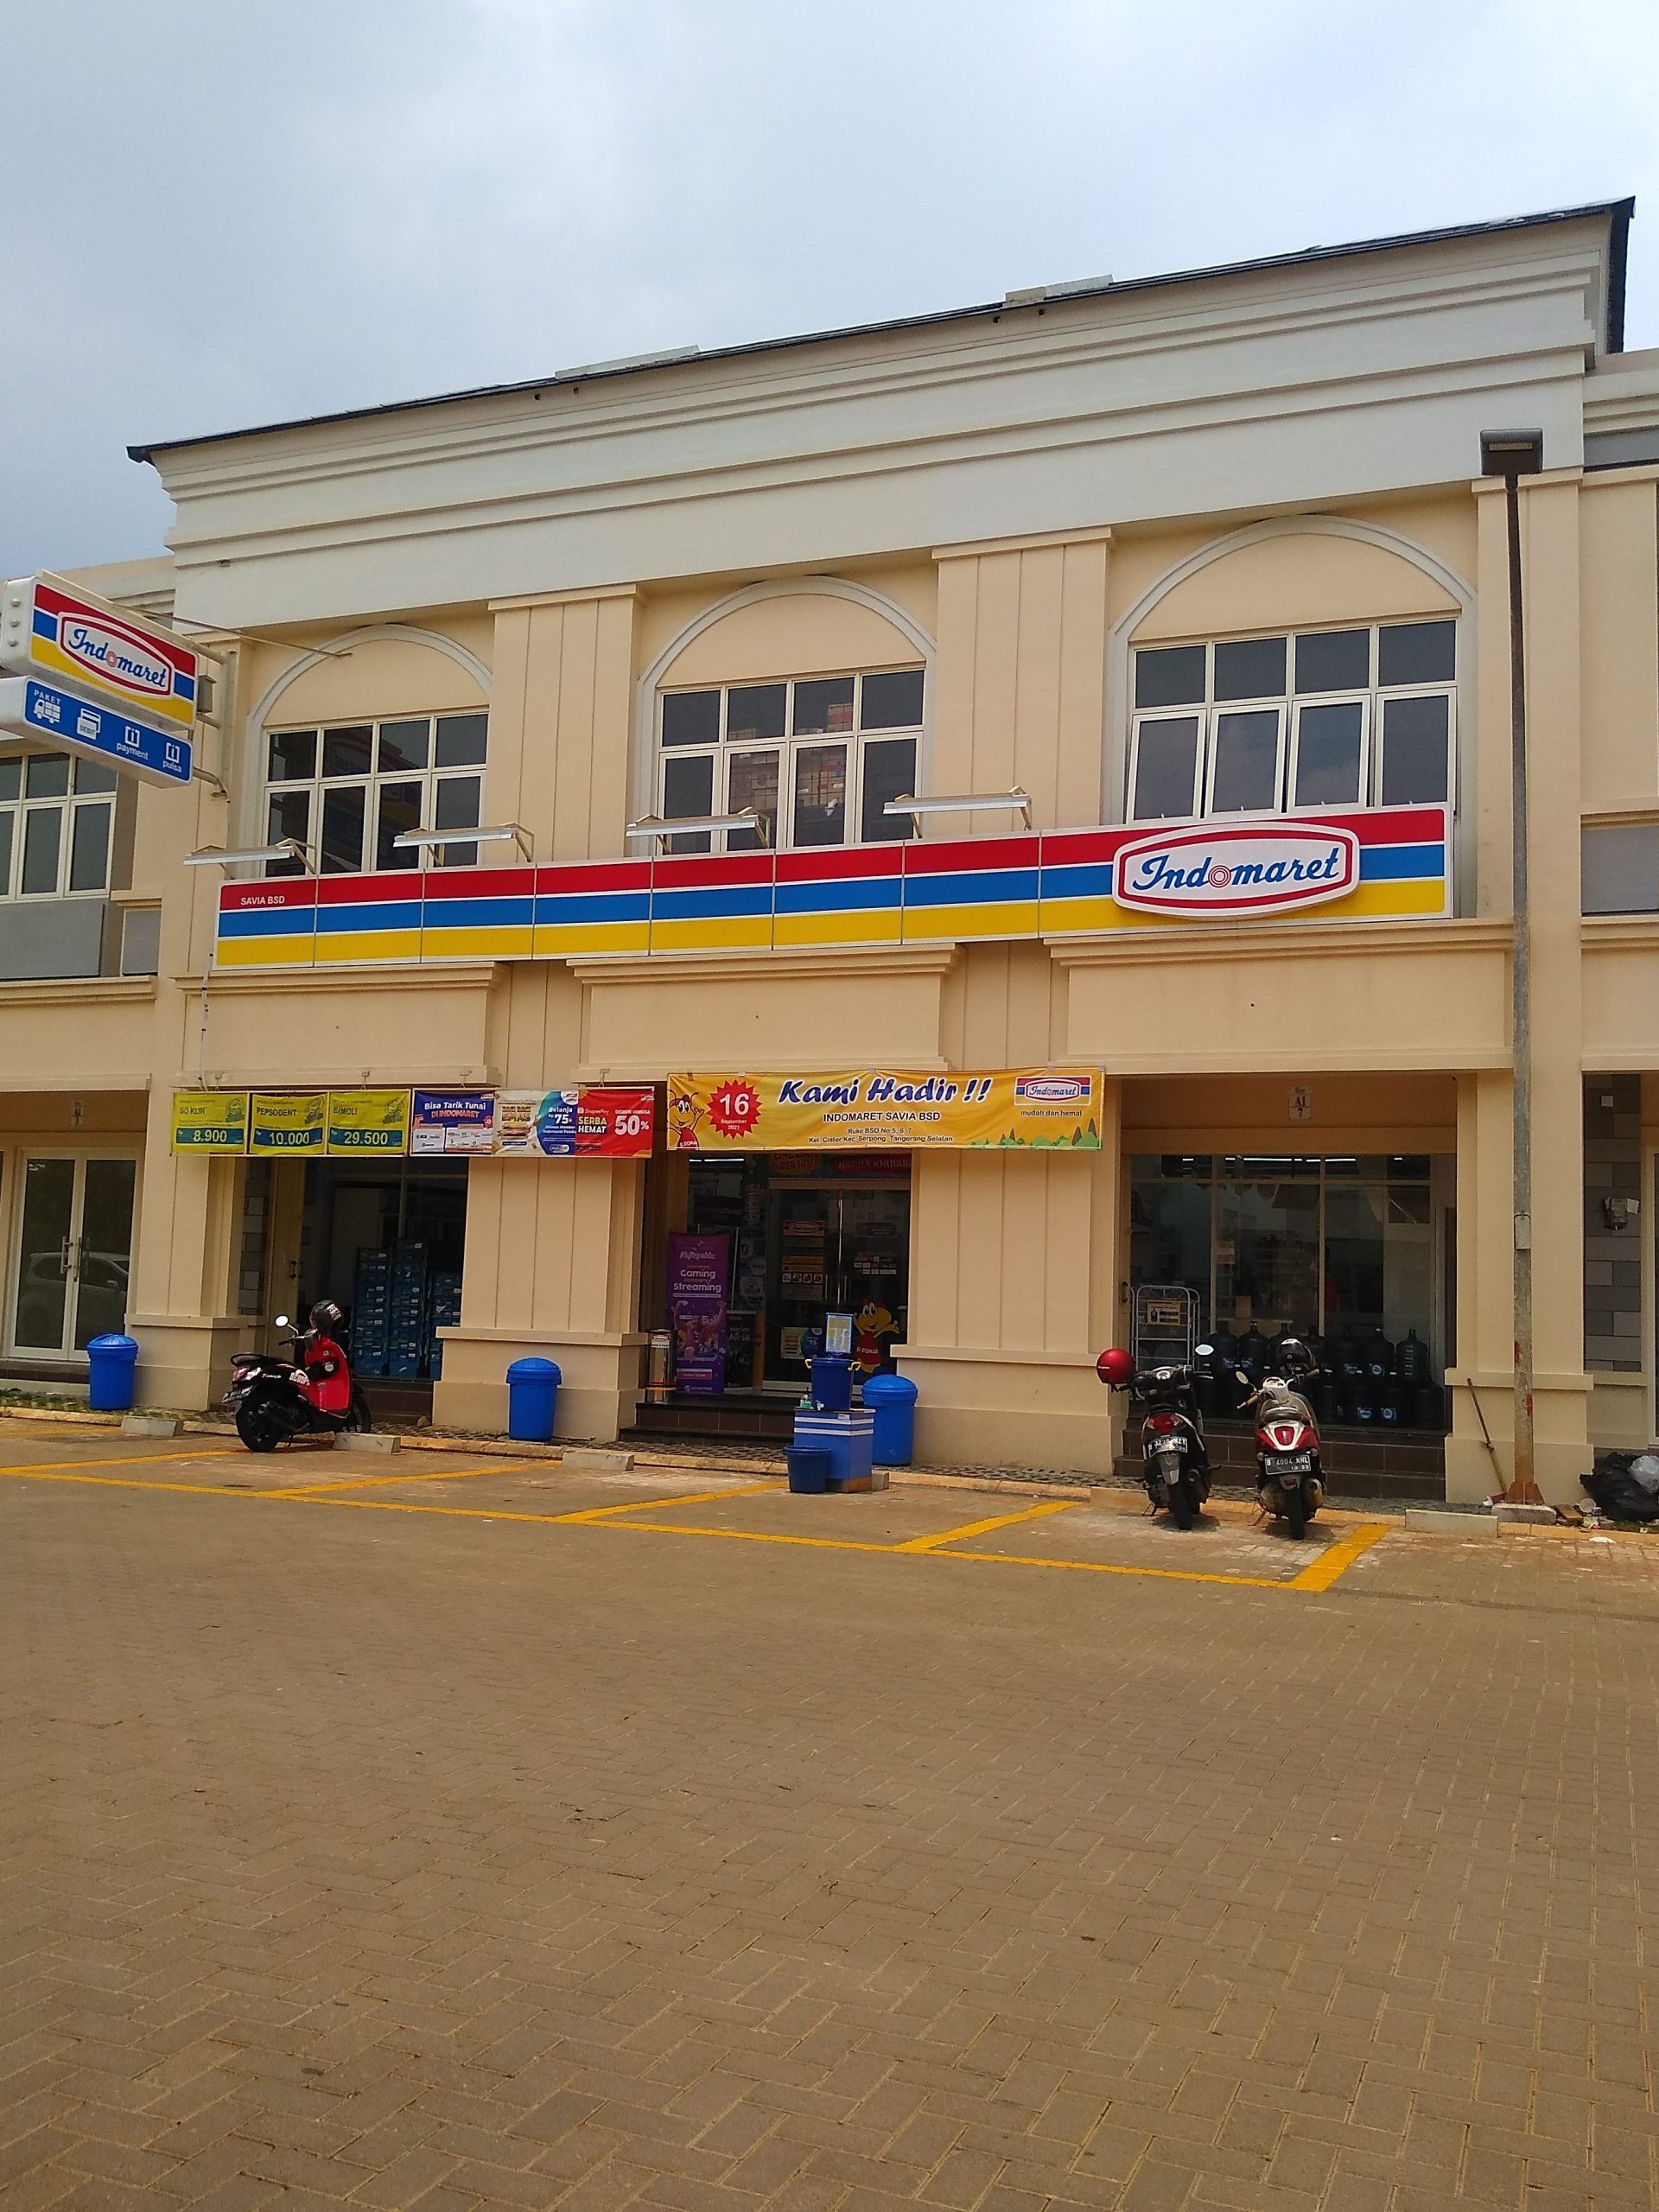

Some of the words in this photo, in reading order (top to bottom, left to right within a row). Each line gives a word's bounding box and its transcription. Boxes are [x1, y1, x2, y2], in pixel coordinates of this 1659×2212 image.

[68, 628, 167, 688] Indomaret
[34, 690, 62, 706] PAKET
[117, 741, 149, 760] payment
[162, 759, 182, 773] pulsa
[1132, 848, 1341, 892] Indomaret
[267, 895, 285, 904] BSD
[779, 1078, 860, 1105] Kami
[867, 1077, 957, 1103] Hadir
[1029, 1085, 1077, 1096] Indomaret
[424, 1102, 442, 1110] Bisa
[443, 1101, 463, 1109] Tarik
[465, 1102, 486, 1110] Tunai
[719, 1093, 750, 1116] 16
[179, 1106, 189, 1115] SO
[190, 1106, 205, 1115] KLIN
[257, 1107, 297, 1116] PEPSODENT
[578, 1116, 607, 1125] SERBA
[823, 1113, 883, 1122] INDOMARET
[885, 1112, 916, 1121] SAVIA
[918, 1112, 940, 1121] BSD
[578, 1125, 607, 1134] HEMAT
[193, 1129, 227, 1142] 8.900
[270, 1132, 310, 1145] 10.000
[344, 1132, 388, 1145] 29.500
[680, 1250, 715, 1261] MyRepublic
[680, 1269, 716, 1280] Gaming
[673, 1282, 721, 1293] Streaming
